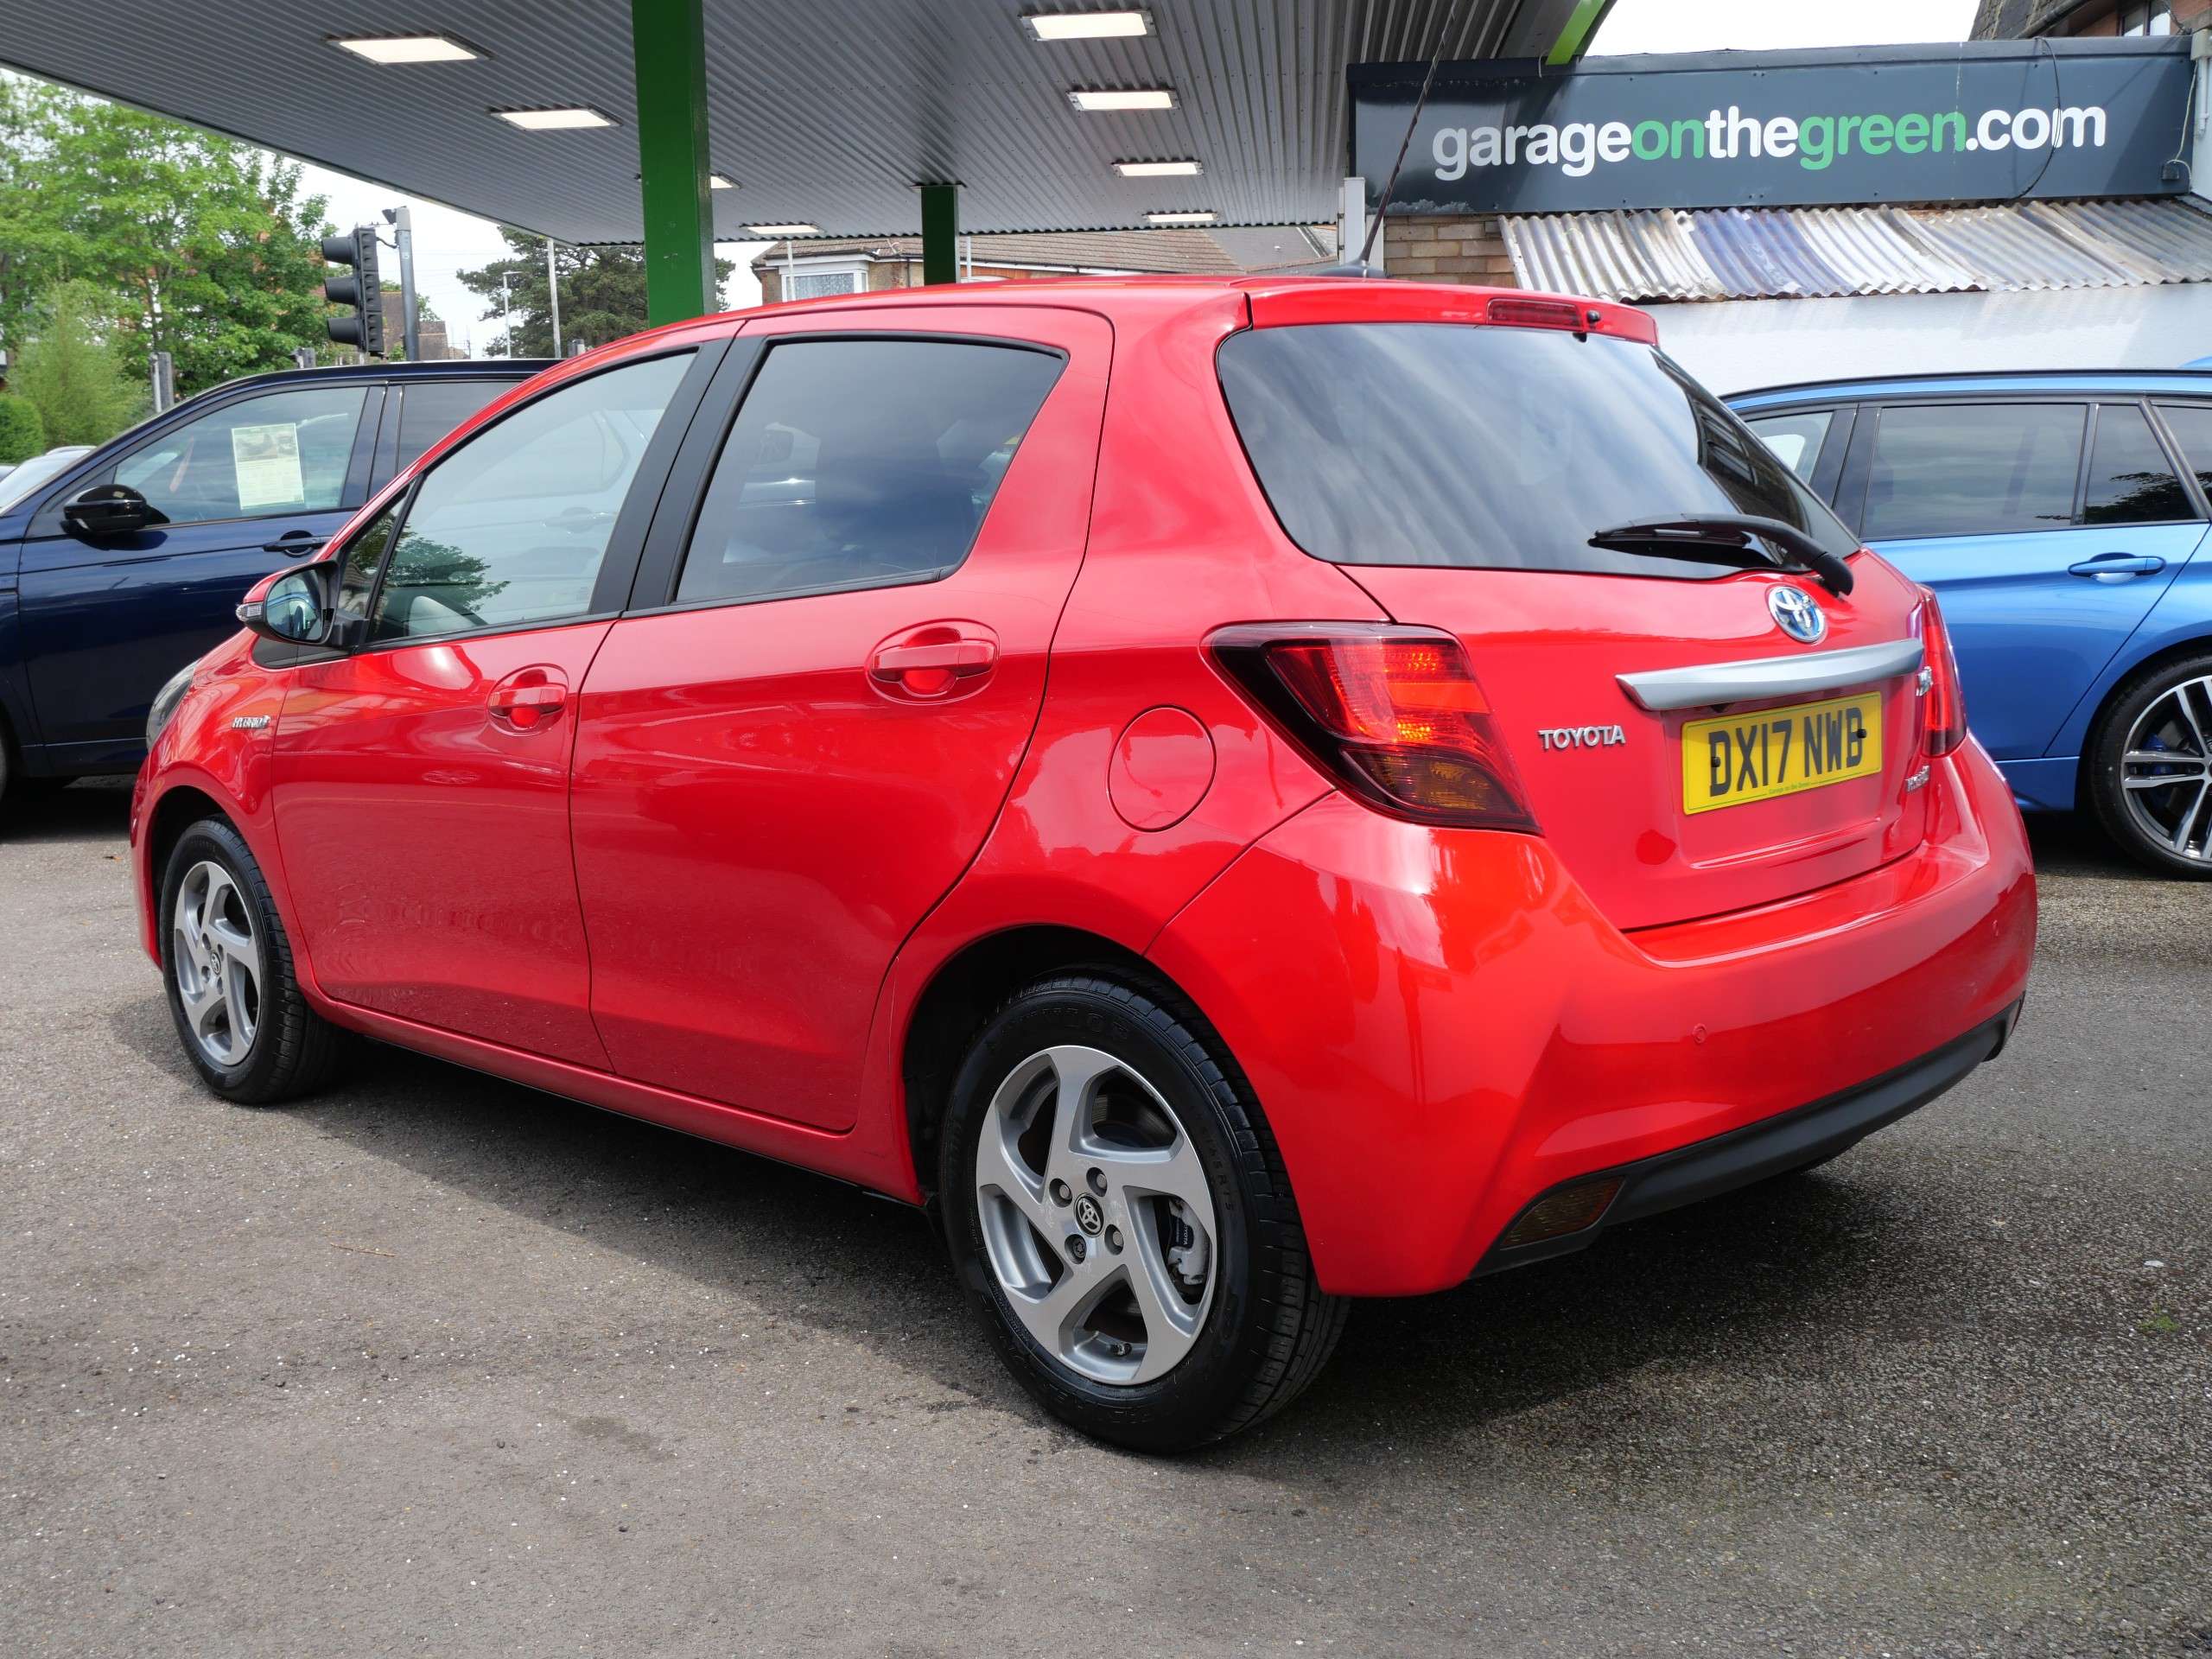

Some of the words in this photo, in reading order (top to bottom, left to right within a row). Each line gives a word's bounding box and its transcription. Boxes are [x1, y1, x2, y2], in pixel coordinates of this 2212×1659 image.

[1432, 105, 2107, 181] garageonthegreen.com
[1538, 724, 1626, 749] TOYOTA
[1708, 718, 1792, 797] DX17
[1803, 707, 1863, 778] NWB
